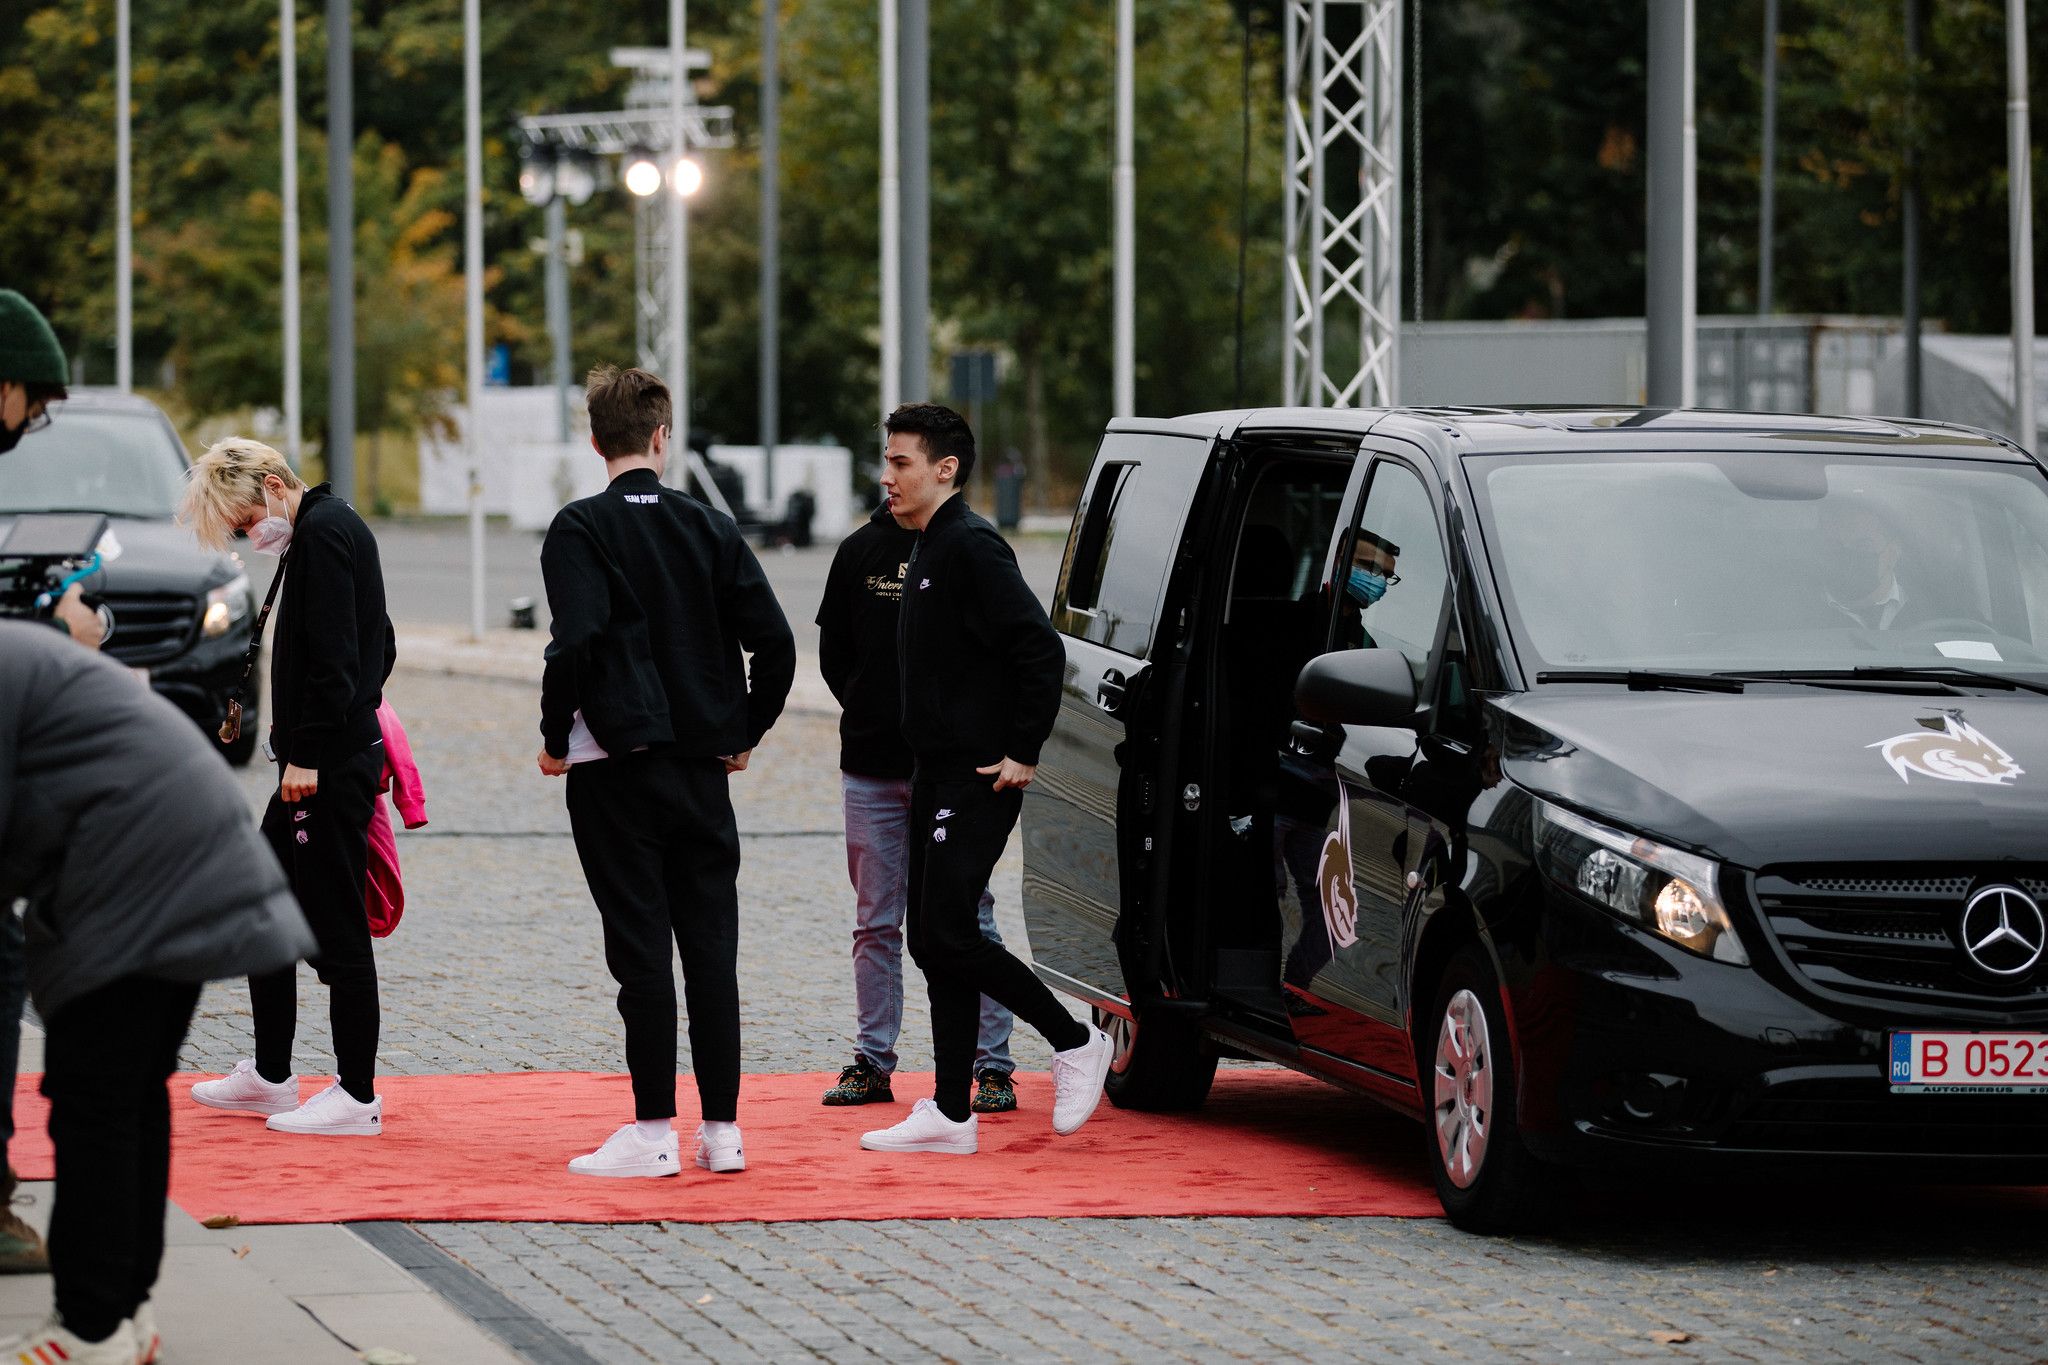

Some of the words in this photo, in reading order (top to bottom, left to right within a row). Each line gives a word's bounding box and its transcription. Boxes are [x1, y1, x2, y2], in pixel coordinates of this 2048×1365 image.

[624, 495, 640, 503] TEAM
[640, 495, 658, 504] SPIRIT
[1922, 1040, 1949, 1077] B
[1965, 1040, 2048, 1077] 0523
[1893, 1061, 1910, 1077] RO
[1923, 1086, 2014, 1094] AUTOEREBUS
